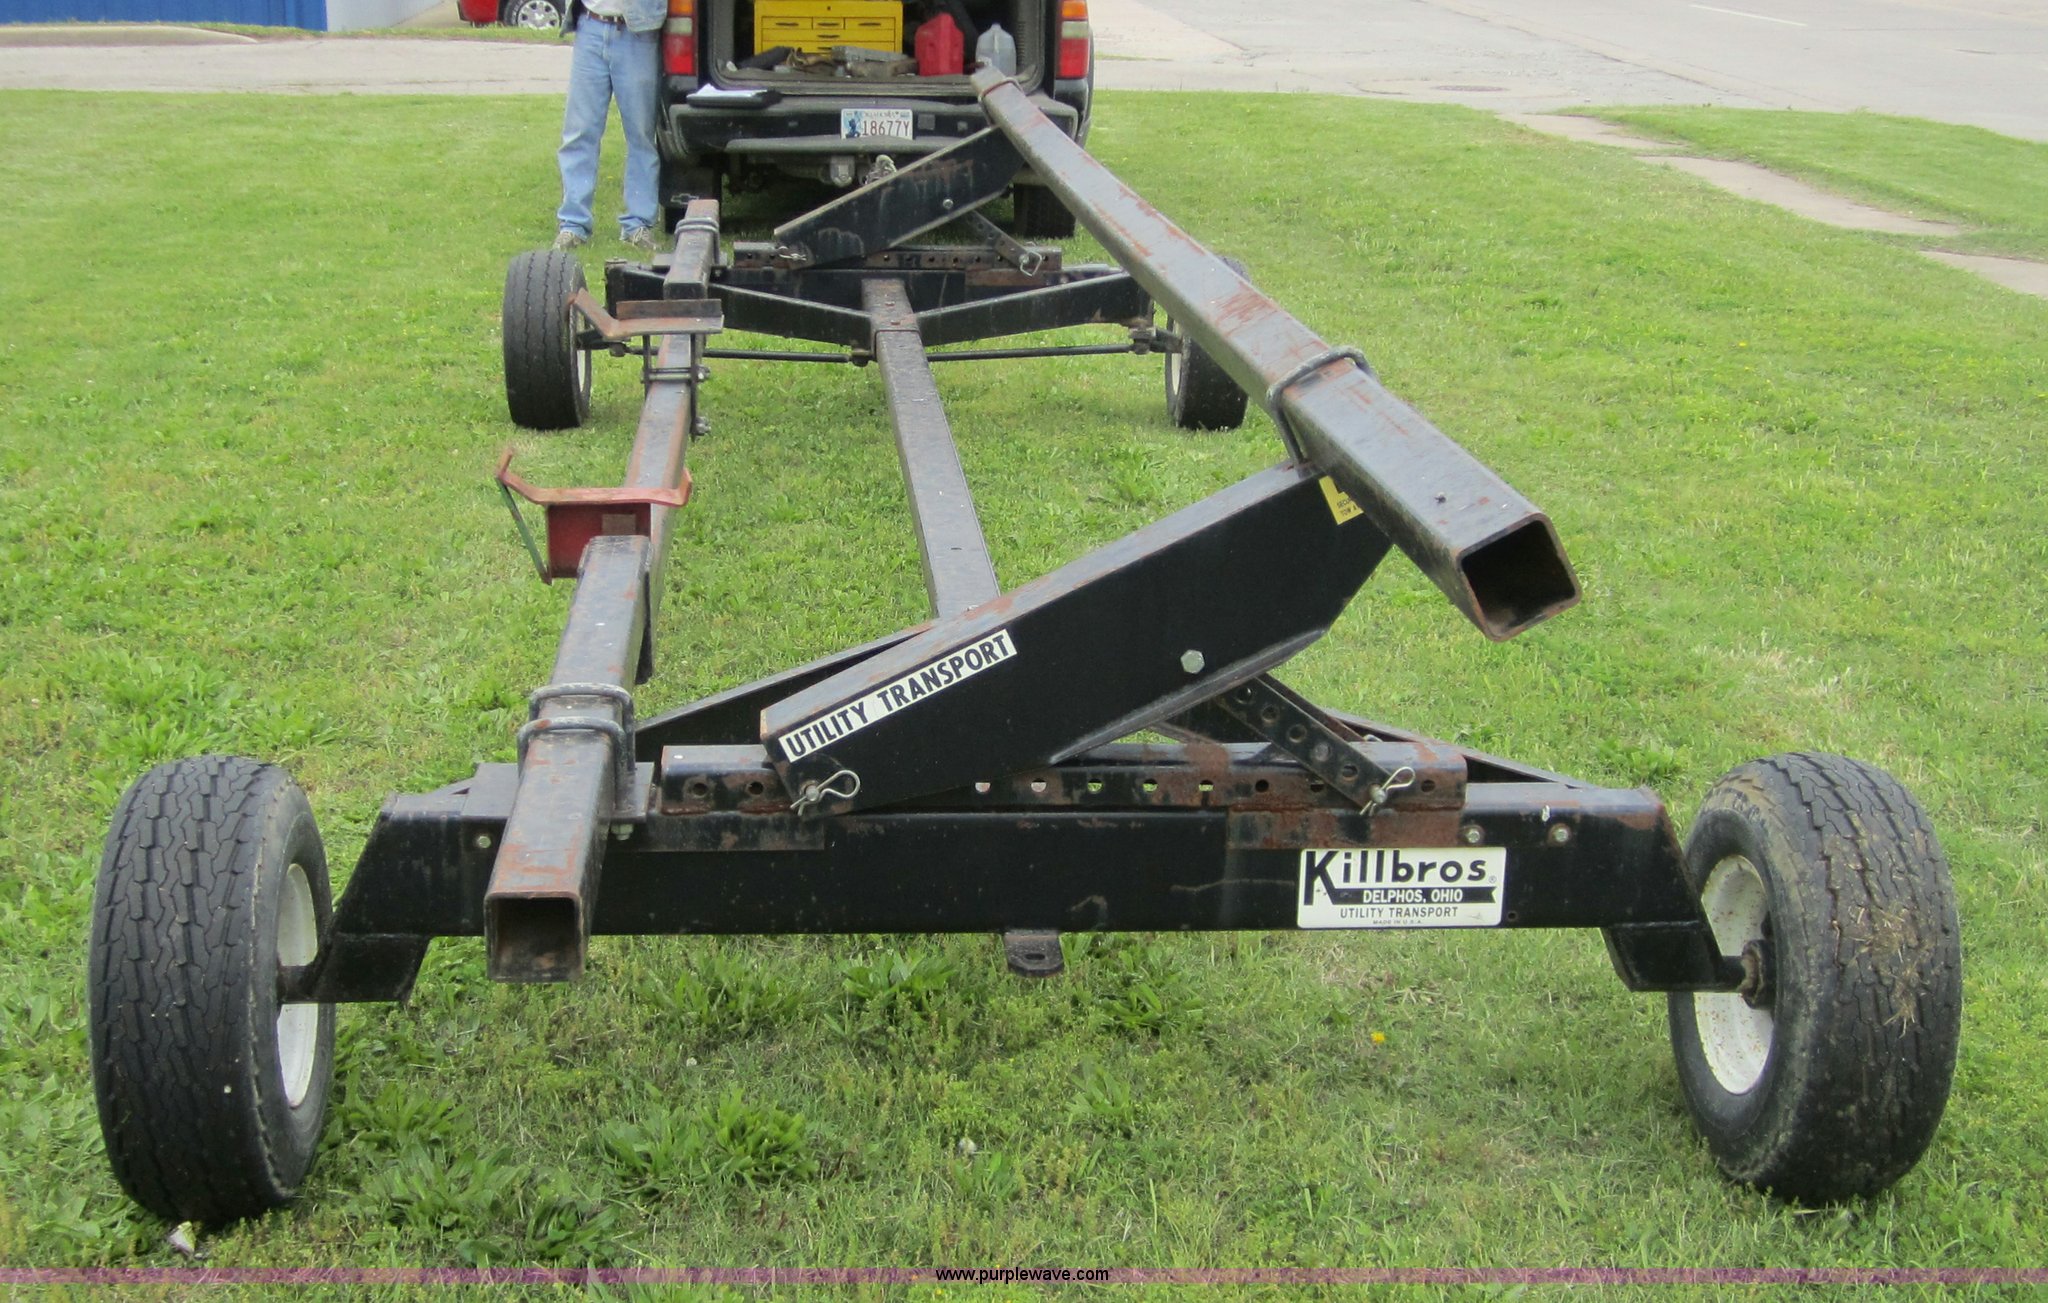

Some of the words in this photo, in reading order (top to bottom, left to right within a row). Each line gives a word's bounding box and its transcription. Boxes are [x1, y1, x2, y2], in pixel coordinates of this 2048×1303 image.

[862, 120, 910, 136] 18677Y
[786, 702, 869, 757] UTILITY
[877, 634, 1010, 712] TRANSPORT
[1304, 850, 1487, 905] Killbros
[1363, 889, 1427, 904] DELPHOS,
[1431, 888, 1463, 902] OHIO
[1340, 907, 1384, 918] UTILITY
[1388, 906, 1458, 918] TRANSPORT
